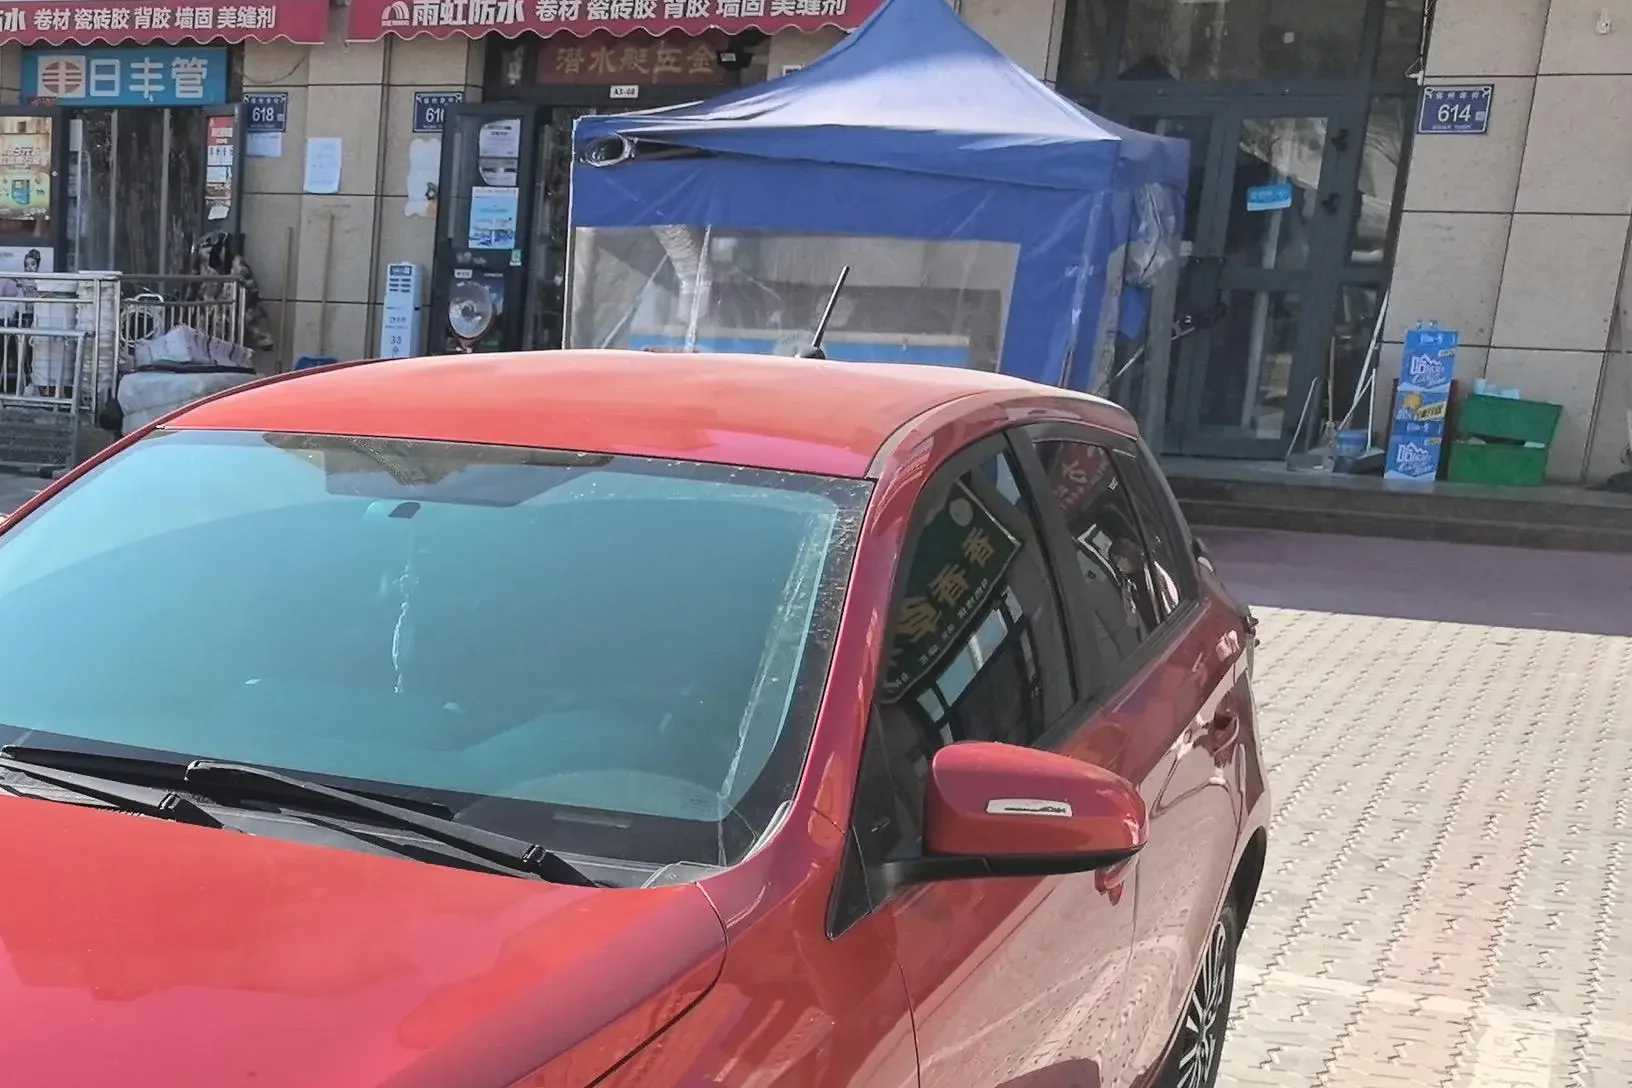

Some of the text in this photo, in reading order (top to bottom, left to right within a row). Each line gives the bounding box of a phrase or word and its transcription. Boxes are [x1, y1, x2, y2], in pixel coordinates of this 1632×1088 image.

[34, 8, 70, 30] 卷材
[74, 8, 129, 30] 瓷砖胶
[134, 7, 171, 29] 背胶
[175, 7, 213, 29] 墙固
[217, 6, 276, 28] 美缝剂
[412, 0, 524, 25] 雨虹防水
[535, 0, 581, 21] 卷材
[587, 0, 657, 20] 瓷砖胶
[90, 57, 207, 99] 日丰管
[252, 106, 274, 122] 618
[1437, 103, 1471, 123] 614
